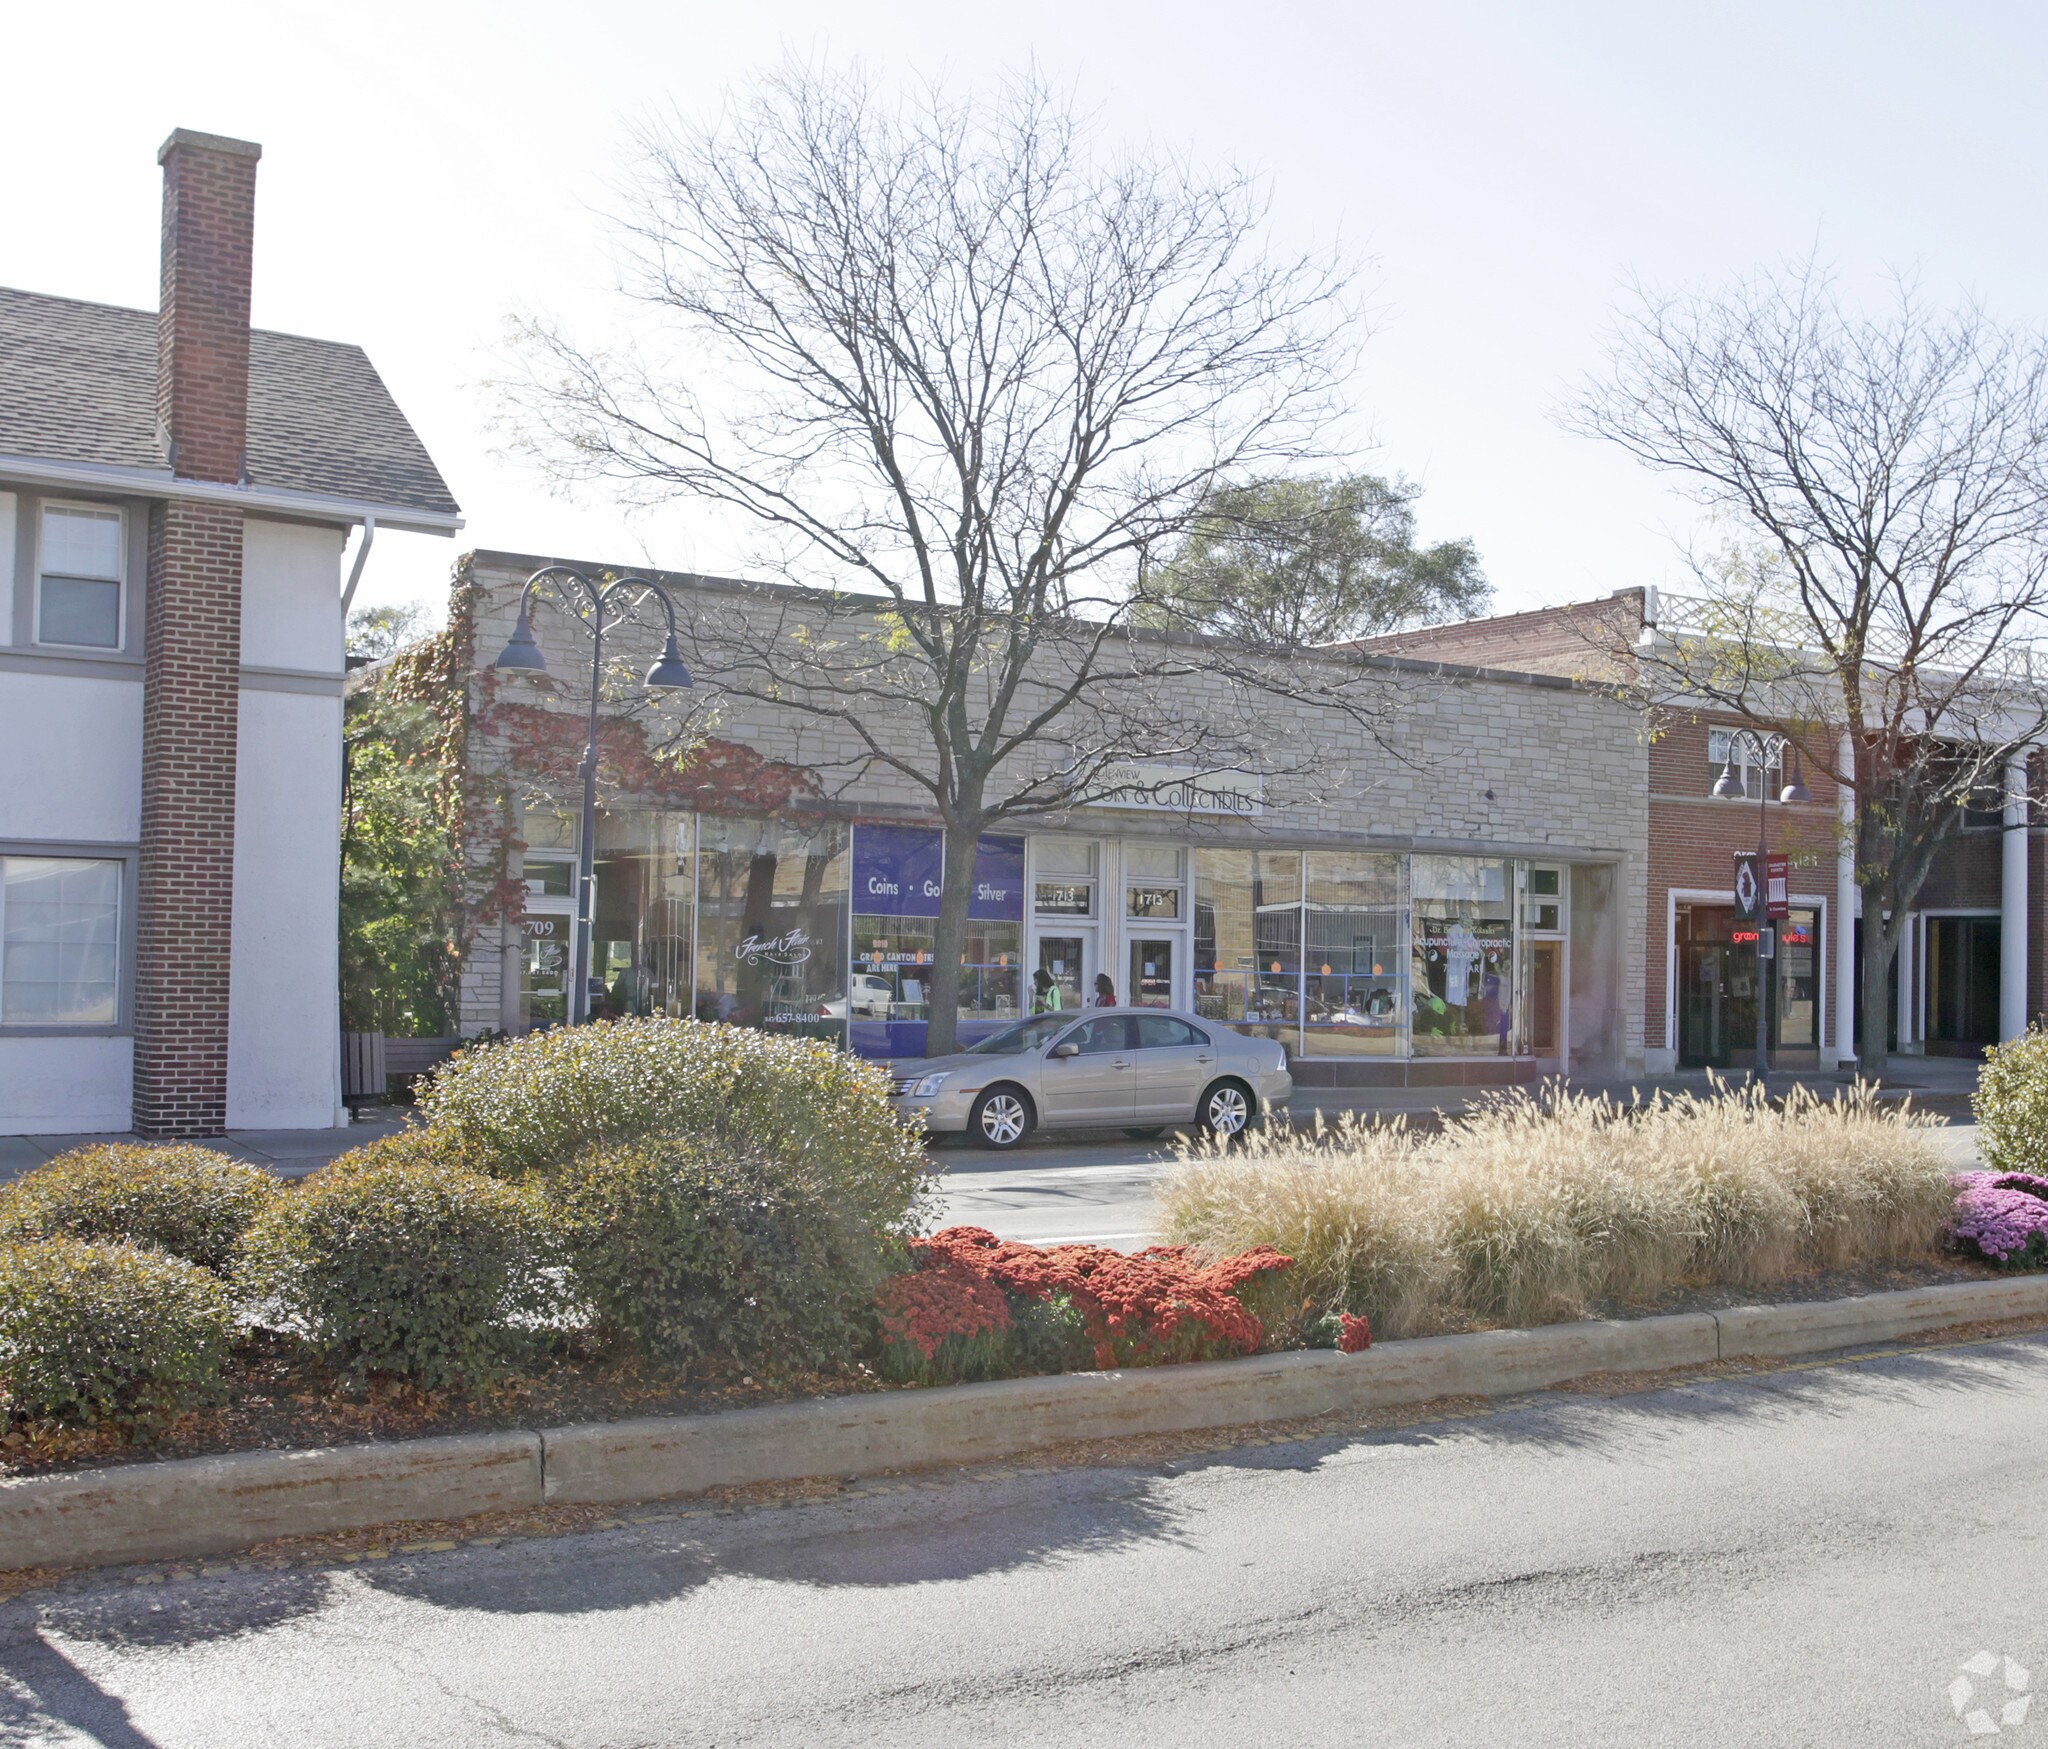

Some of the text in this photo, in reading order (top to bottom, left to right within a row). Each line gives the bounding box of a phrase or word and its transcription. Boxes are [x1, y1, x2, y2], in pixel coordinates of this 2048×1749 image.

[1134, 780, 1149, 805] &
[868, 877, 1006, 901] Coins Go Silver
[1139, 894, 1163, 906] 1713
[735, 935, 779, 959] French
[886, 953, 916, 962] CANYON
[866, 964, 897, 973] ARE HERE
[775, 1012, 820, 1024] 657-8400
